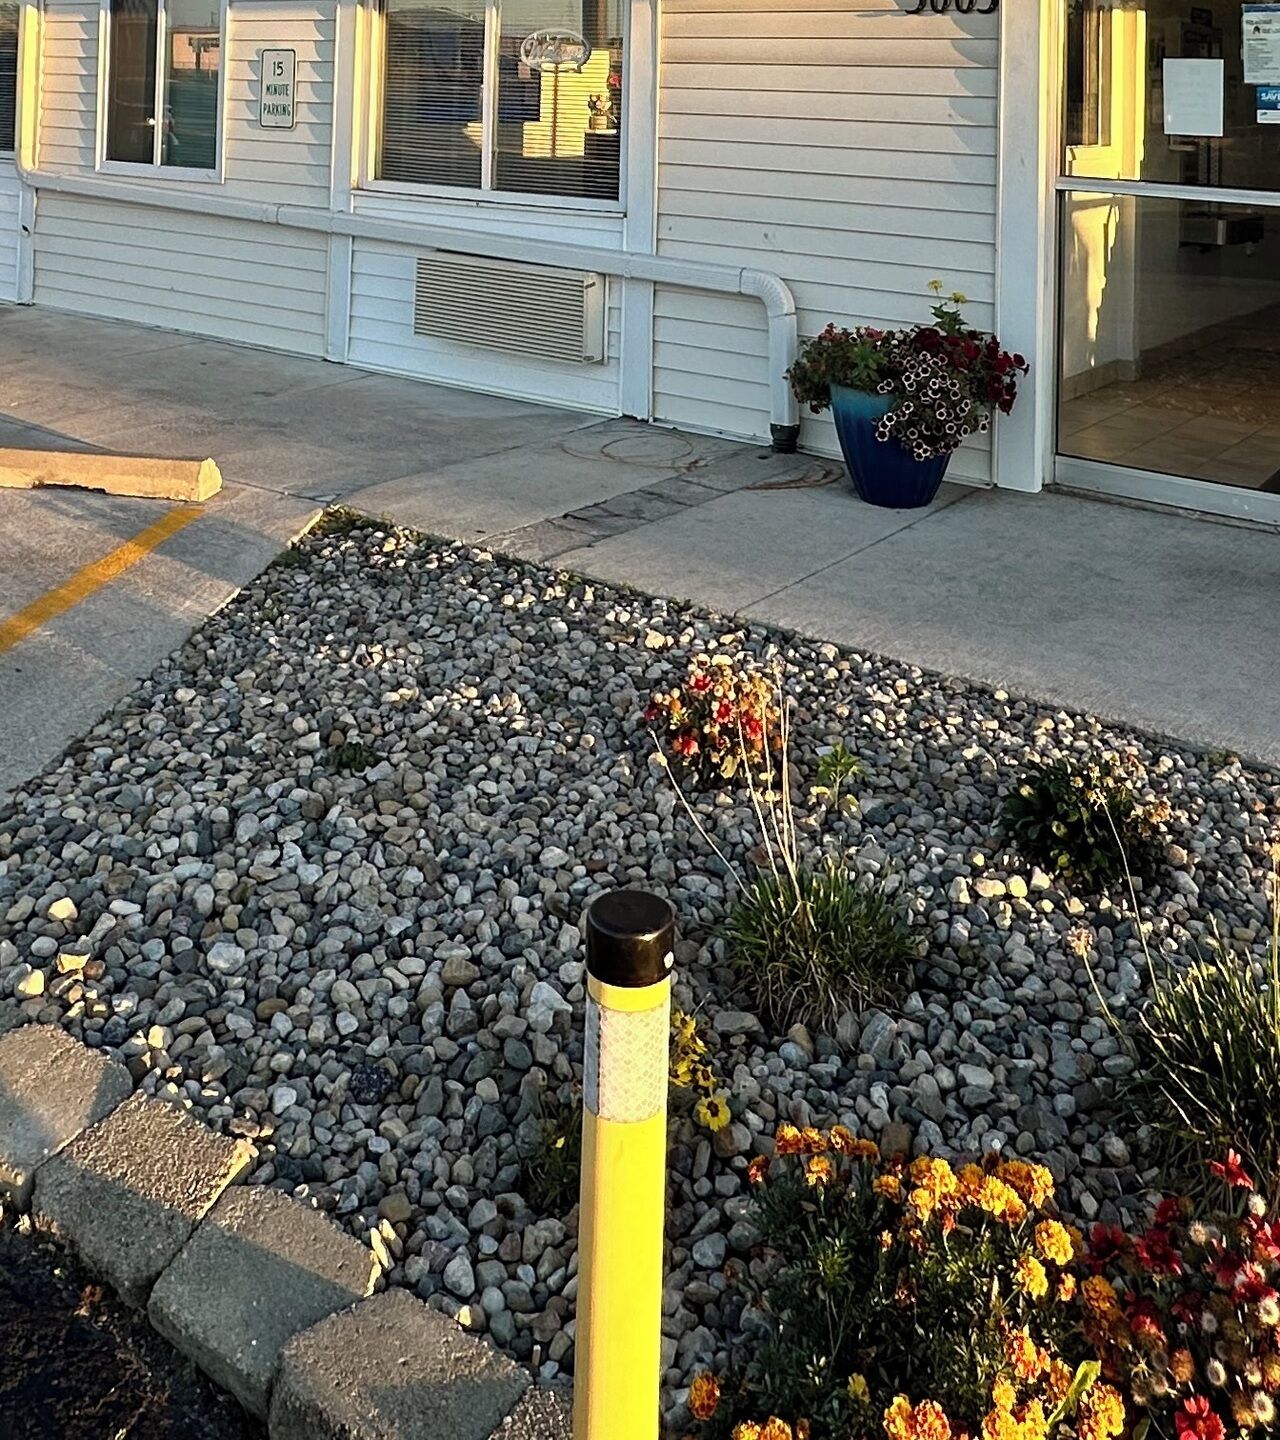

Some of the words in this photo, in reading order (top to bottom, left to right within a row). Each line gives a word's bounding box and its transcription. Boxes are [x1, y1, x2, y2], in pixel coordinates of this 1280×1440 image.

[272, 61, 284, 77] 15
[266, 83, 290, 97] MINUTE
[263, 102, 291, 117] PARKING
